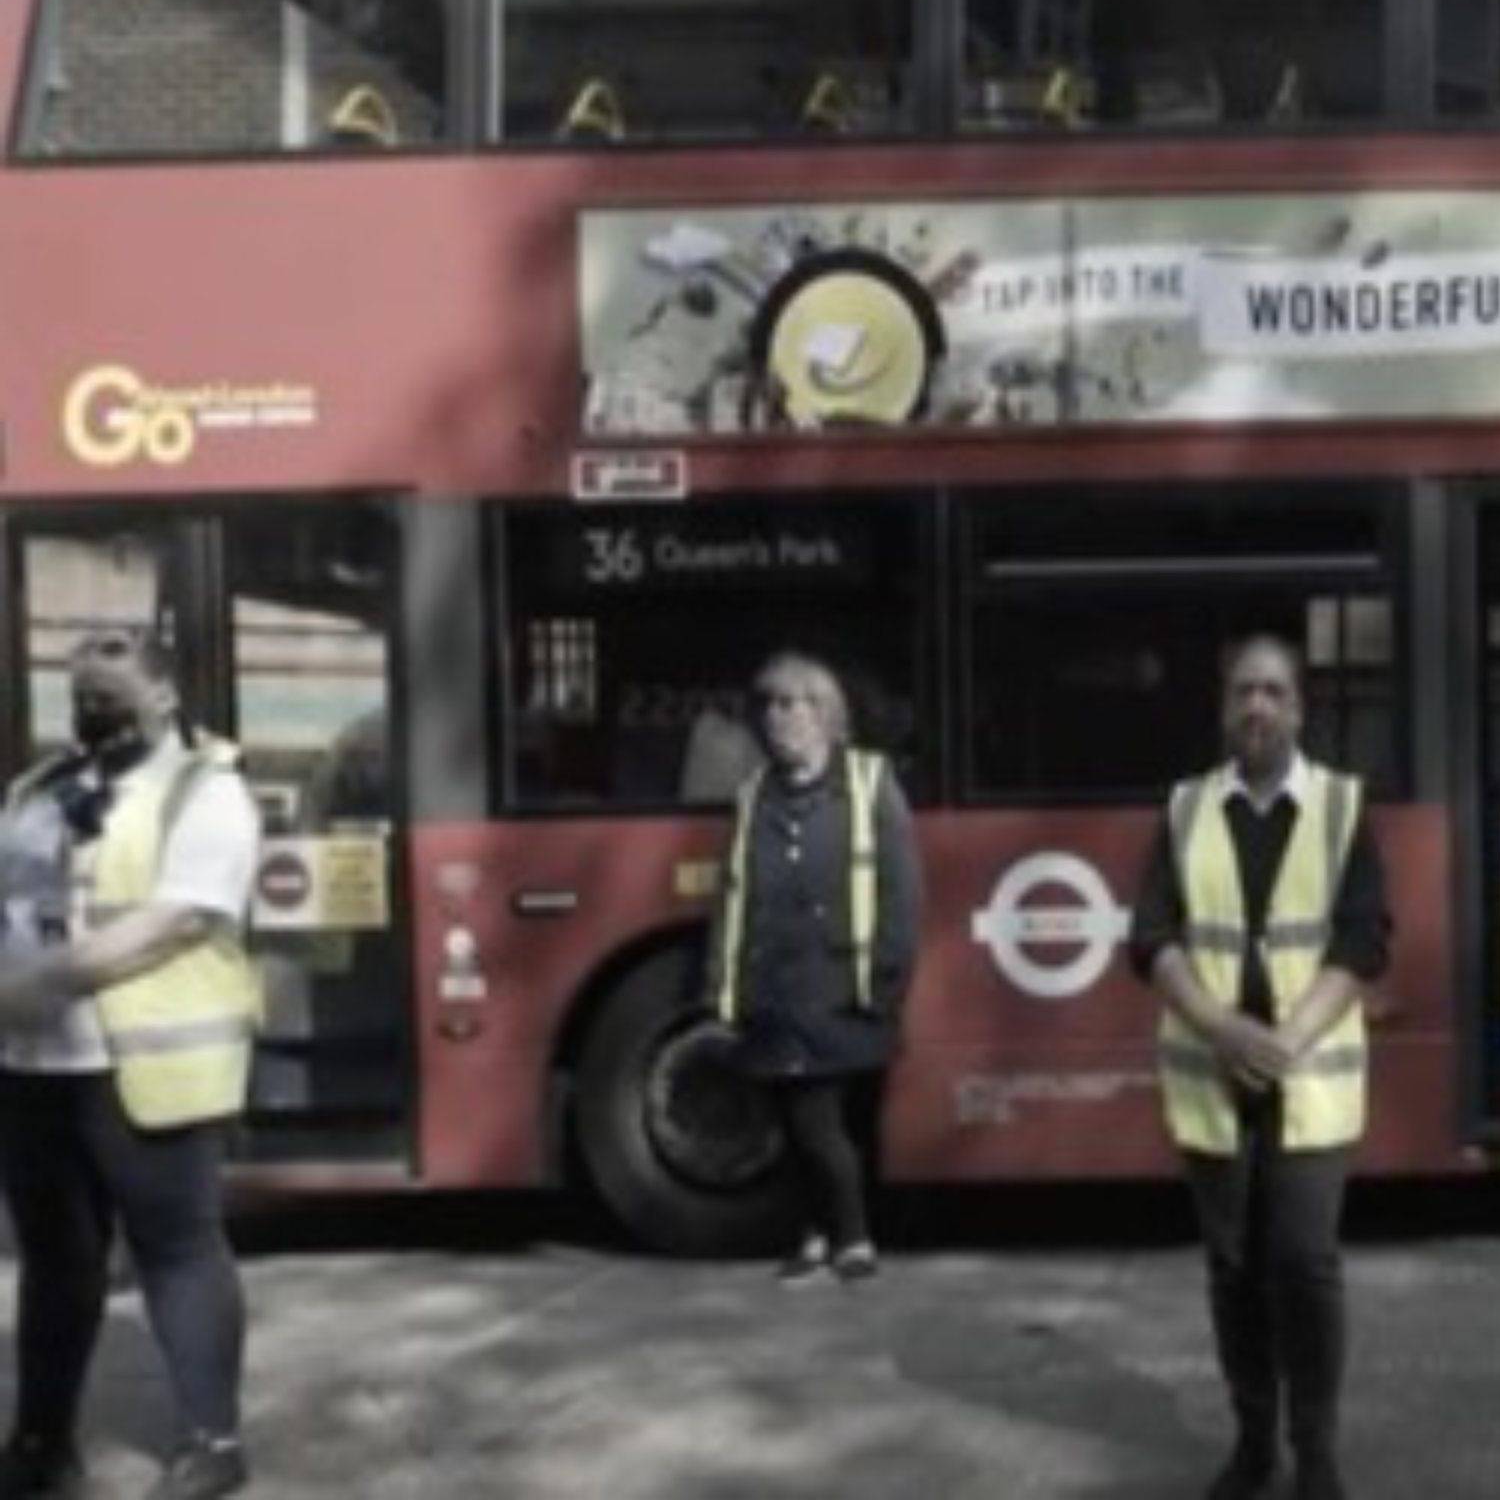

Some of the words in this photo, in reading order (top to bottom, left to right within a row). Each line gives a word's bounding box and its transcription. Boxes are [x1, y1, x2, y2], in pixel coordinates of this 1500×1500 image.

[1132, 262, 1186, 300] THE
[63, 362, 195, 466] Go
[583, 527, 646, 584] 36
